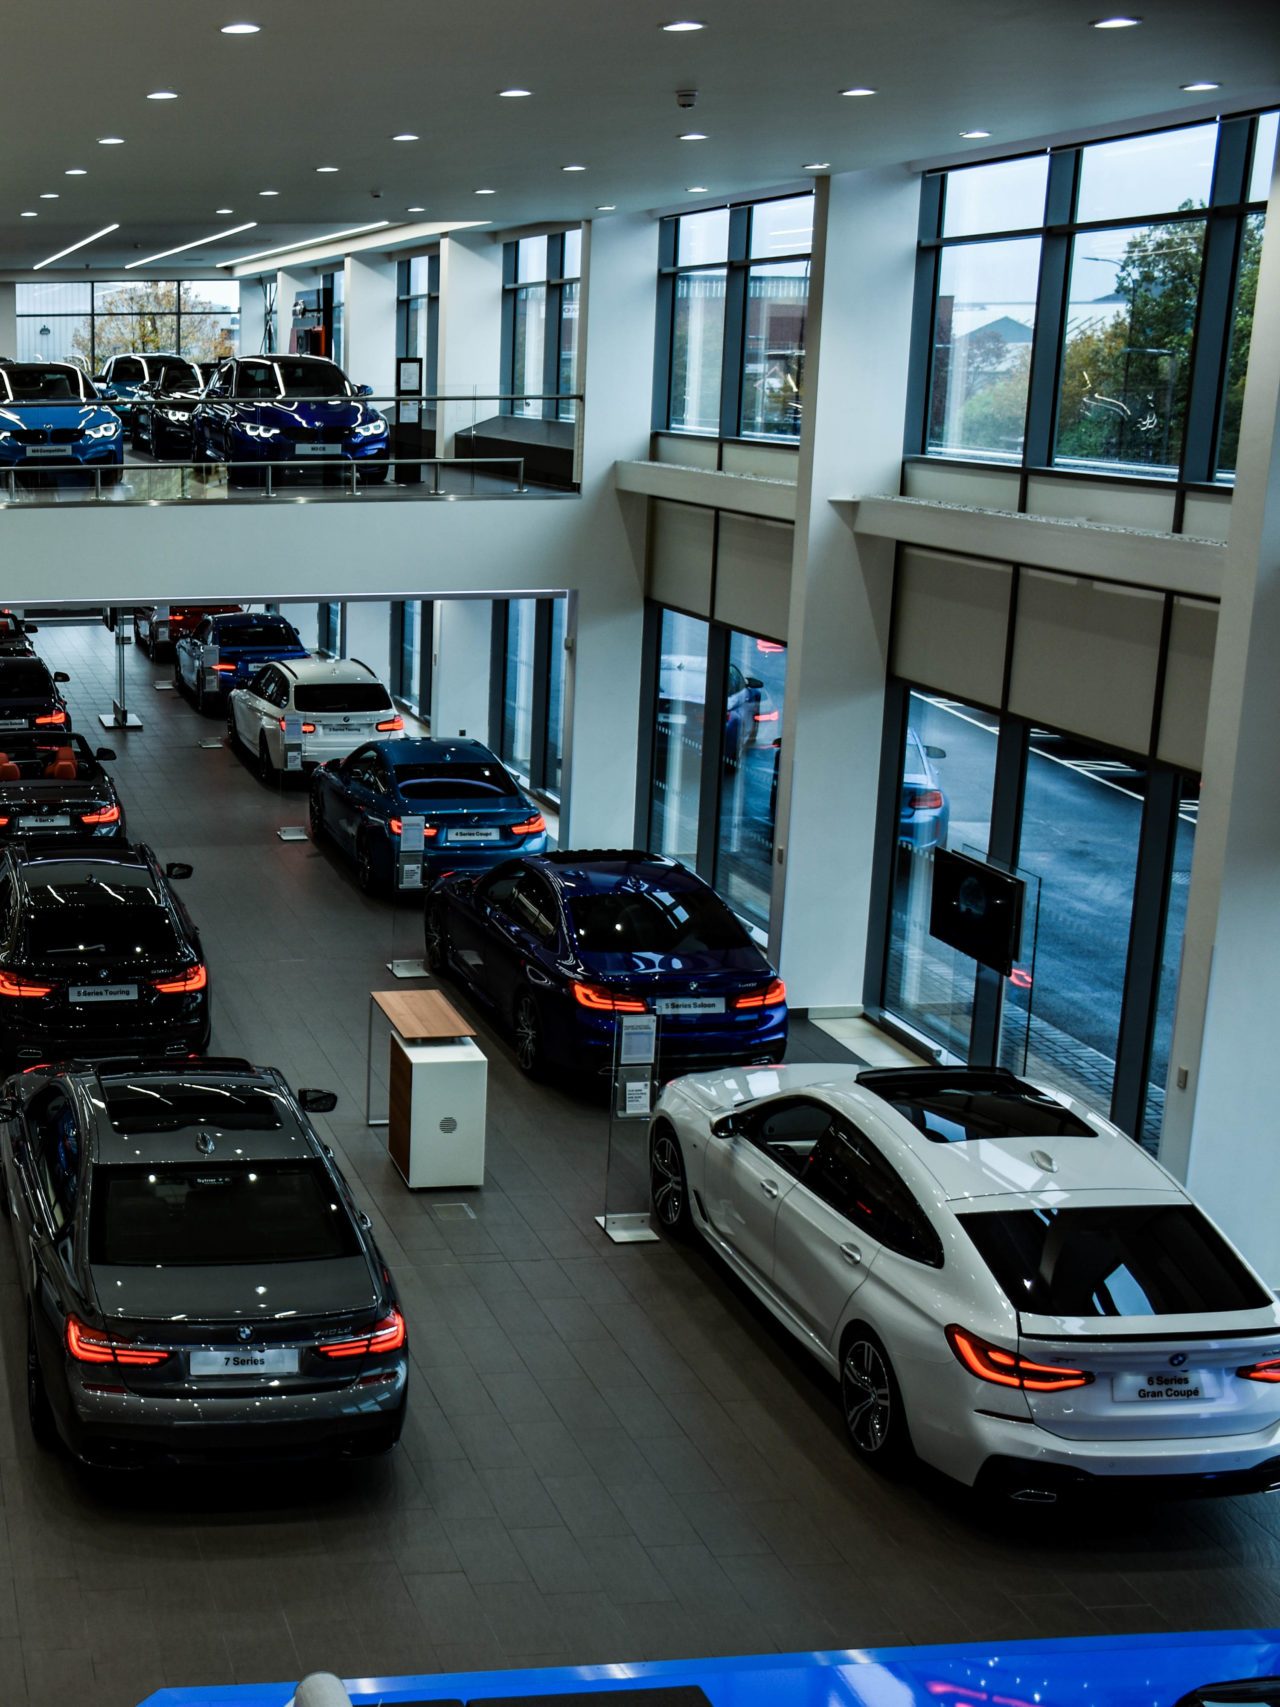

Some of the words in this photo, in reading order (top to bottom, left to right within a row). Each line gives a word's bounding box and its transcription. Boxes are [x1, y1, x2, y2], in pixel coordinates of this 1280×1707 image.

[224, 1357, 230, 1366] 7
[232, 1356, 265, 1366] Series
[1147, 1376, 1154, 1386] 6
[1156, 1376, 1189, 1385] Series
[1138, 1388, 1164, 1398] Gran
[1165, 1387, 1200, 1398] Coupé
